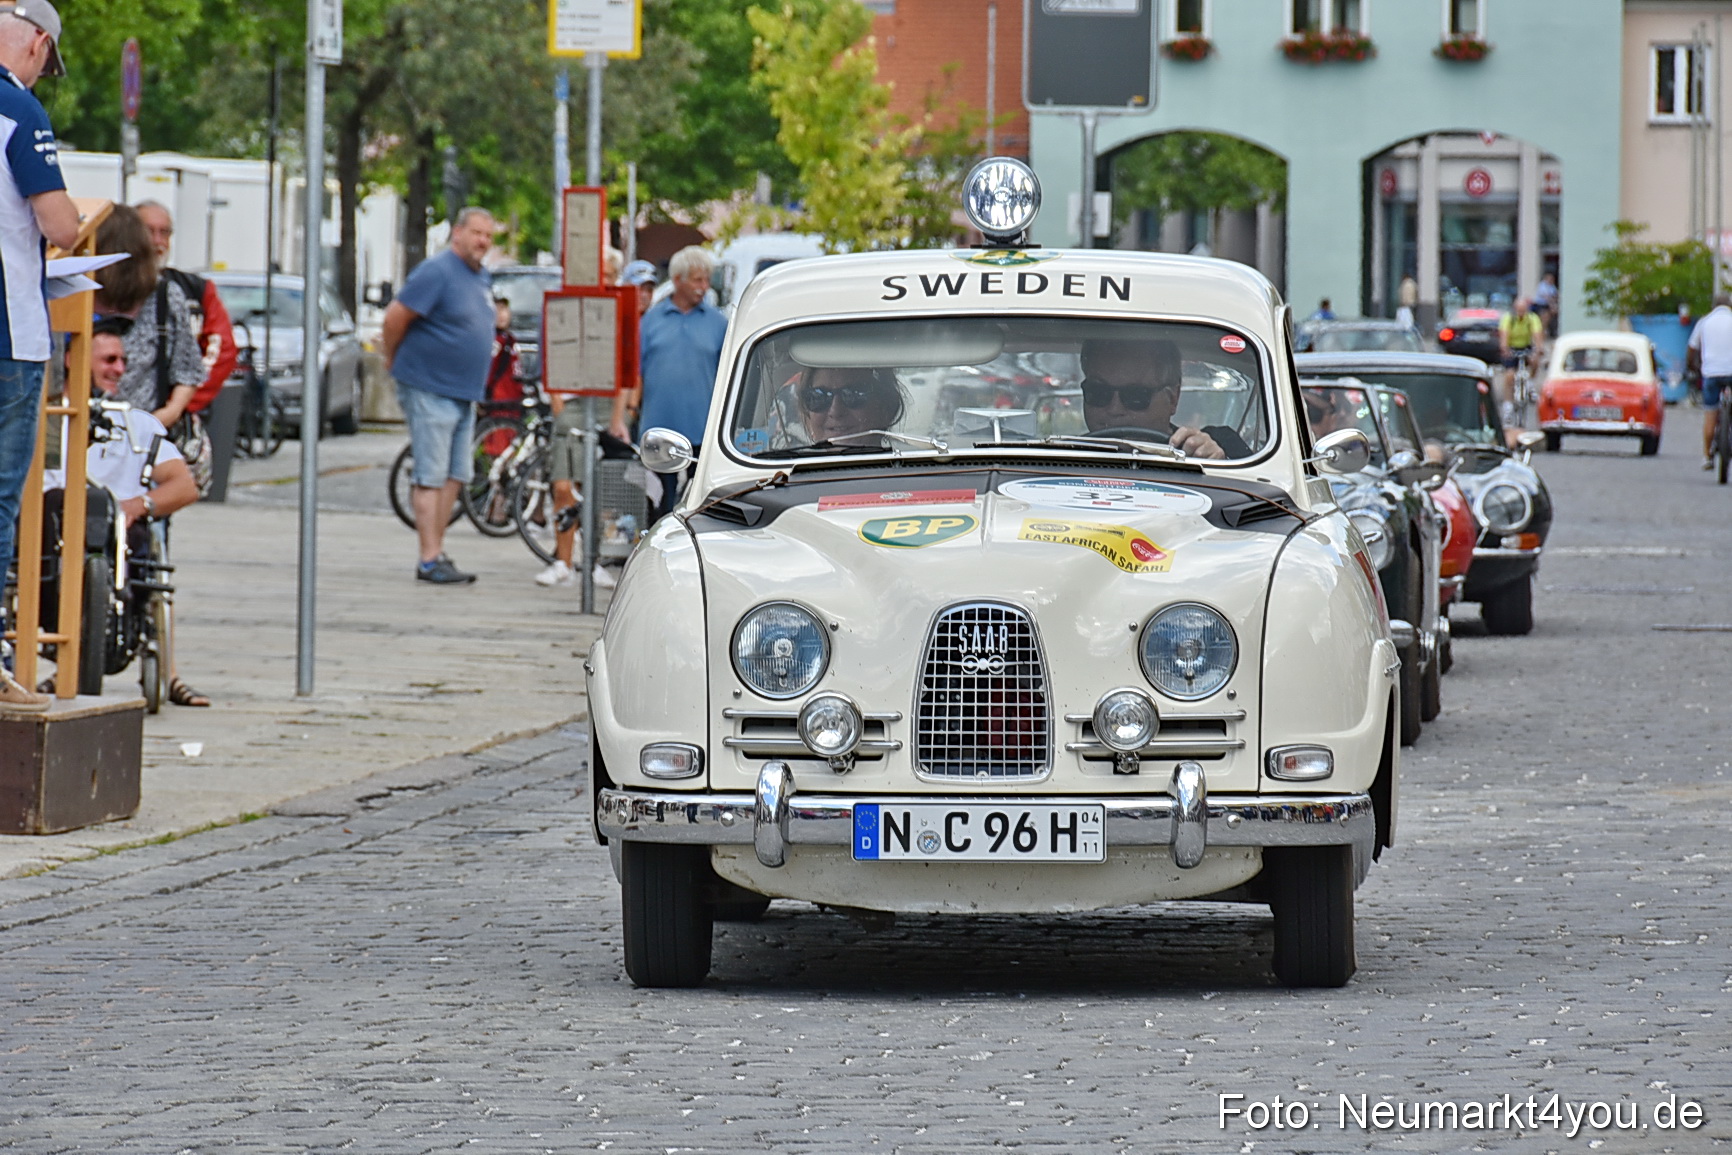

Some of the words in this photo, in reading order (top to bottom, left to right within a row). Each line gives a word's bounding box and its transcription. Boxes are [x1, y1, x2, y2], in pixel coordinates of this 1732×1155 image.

[881, 271, 1131, 302] SWEDEN
[1072, 490, 1134, 503] 32
[879, 518, 965, 540] BP
[1025, 532, 1057, 542] EAST
[1062, 536, 1117, 562] AFRICAN
[1117, 556, 1165, 573] SAFARI
[958, 625, 1008, 654] SAAB
[1081, 811, 1099, 823] 04
[861, 836, 872, 850] D
[883, 811, 911, 853] N
[1083, 842, 1098, 853] 11
